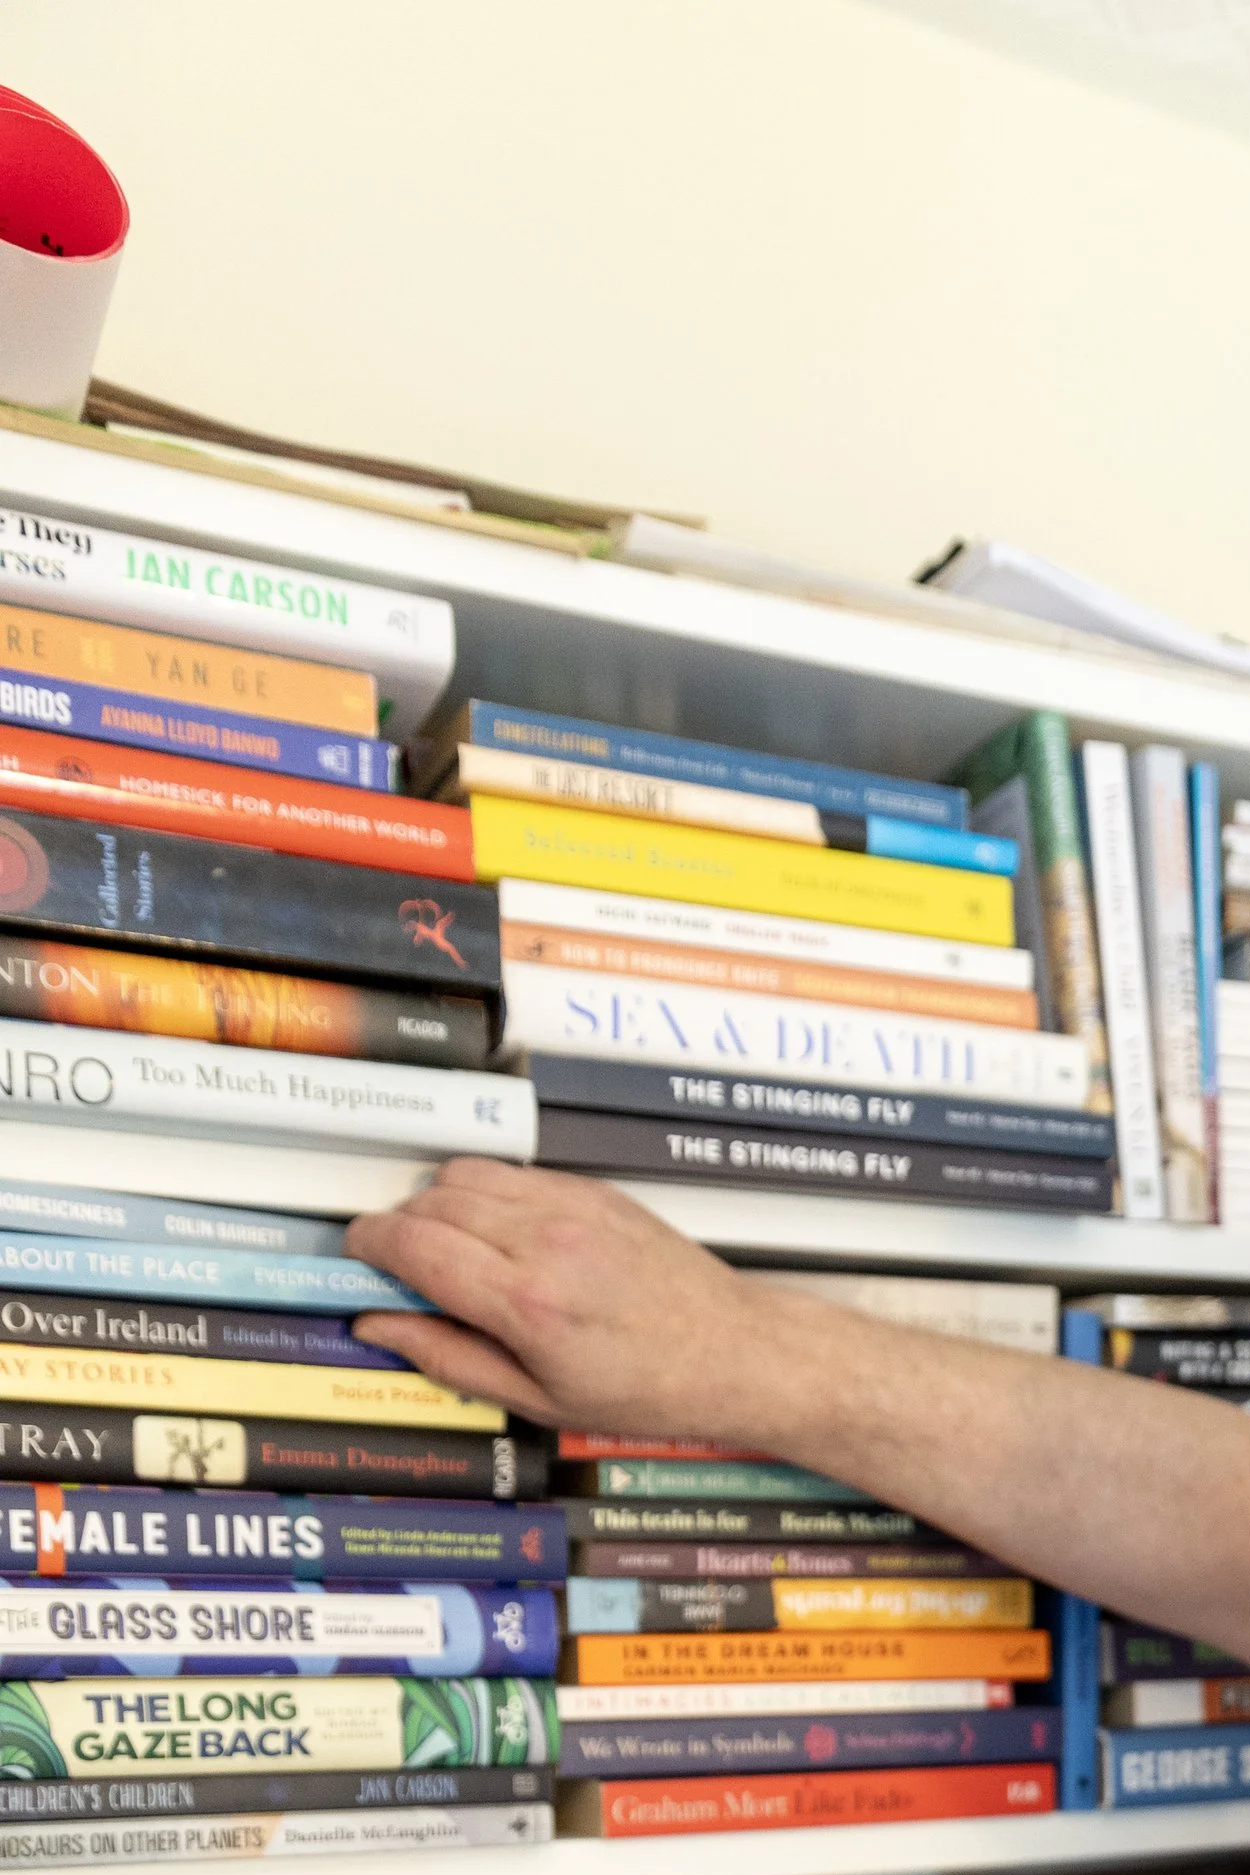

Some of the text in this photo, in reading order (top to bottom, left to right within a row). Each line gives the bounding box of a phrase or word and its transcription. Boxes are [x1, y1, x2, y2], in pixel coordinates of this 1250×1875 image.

[18, 517, 93, 555] They
[126, 548, 350, 627] JAN CARSON
[145, 650, 269, 698] YAN GE
[0, 681, 72, 726] BIRDS
[119, 774, 448, 848] HOMESICK FOR ANOTHER WORLD
[564, 984, 978, 1084] SEX & DEATH
[132, 1056, 187, 1086] Too
[195, 1063, 277, 1097] Much
[288, 1072, 435, 1115] Happiness
[669, 1075, 723, 1105] THE
[729, 1082, 857, 1121] STINGING
[866, 1094, 914, 1126] FLY
[666, 1132, 720, 1164] THE
[727, 1138, 857, 1176] STINGING
[863, 1153, 912, 1181] FLY
[0, 1191, 127, 1228] OMESICKNESS
[164, 1214, 213, 1240] COLIN
[85, 1251, 132, 1279] THE
[143, 1256, 220, 1284] PLACE
[254, 1266, 323, 1289] EVELYN
[1, 1302, 87, 1338] Over
[95, 1308, 209, 1349] Ireland
[222, 1325, 275, 1348] Edited
[45, 1358, 174, 1388] STORIES
[260, 1441, 338, 1470] Emma
[346, 1446, 469, 1478] Donoghue
[493, 1437, 517, 1498] PICADOR
[0, 1508, 325, 1560] EMALE LINES
[48, 1601, 178, 1643] GLASS
[189, 1602, 316, 1642] SHORE
[622, 1639, 905, 1661] IN THE DREAM HOUSE
[578, 1727, 796, 1761] We Wrote in Symbols
[356, 1774, 459, 1804] JAN CARSON
[1121, 1745, 1230, 1792] GEORGE
[0, 1780, 196, 1815] CHILDREN'S CHILDREN
[610, 1793, 719, 1827] Graham
[723, 1788, 788, 1820] Mort
[90, 1830, 116, 1856] ON
[122, 1828, 178, 1853] OTHER
[185, 1825, 264, 1851] PLANETS
